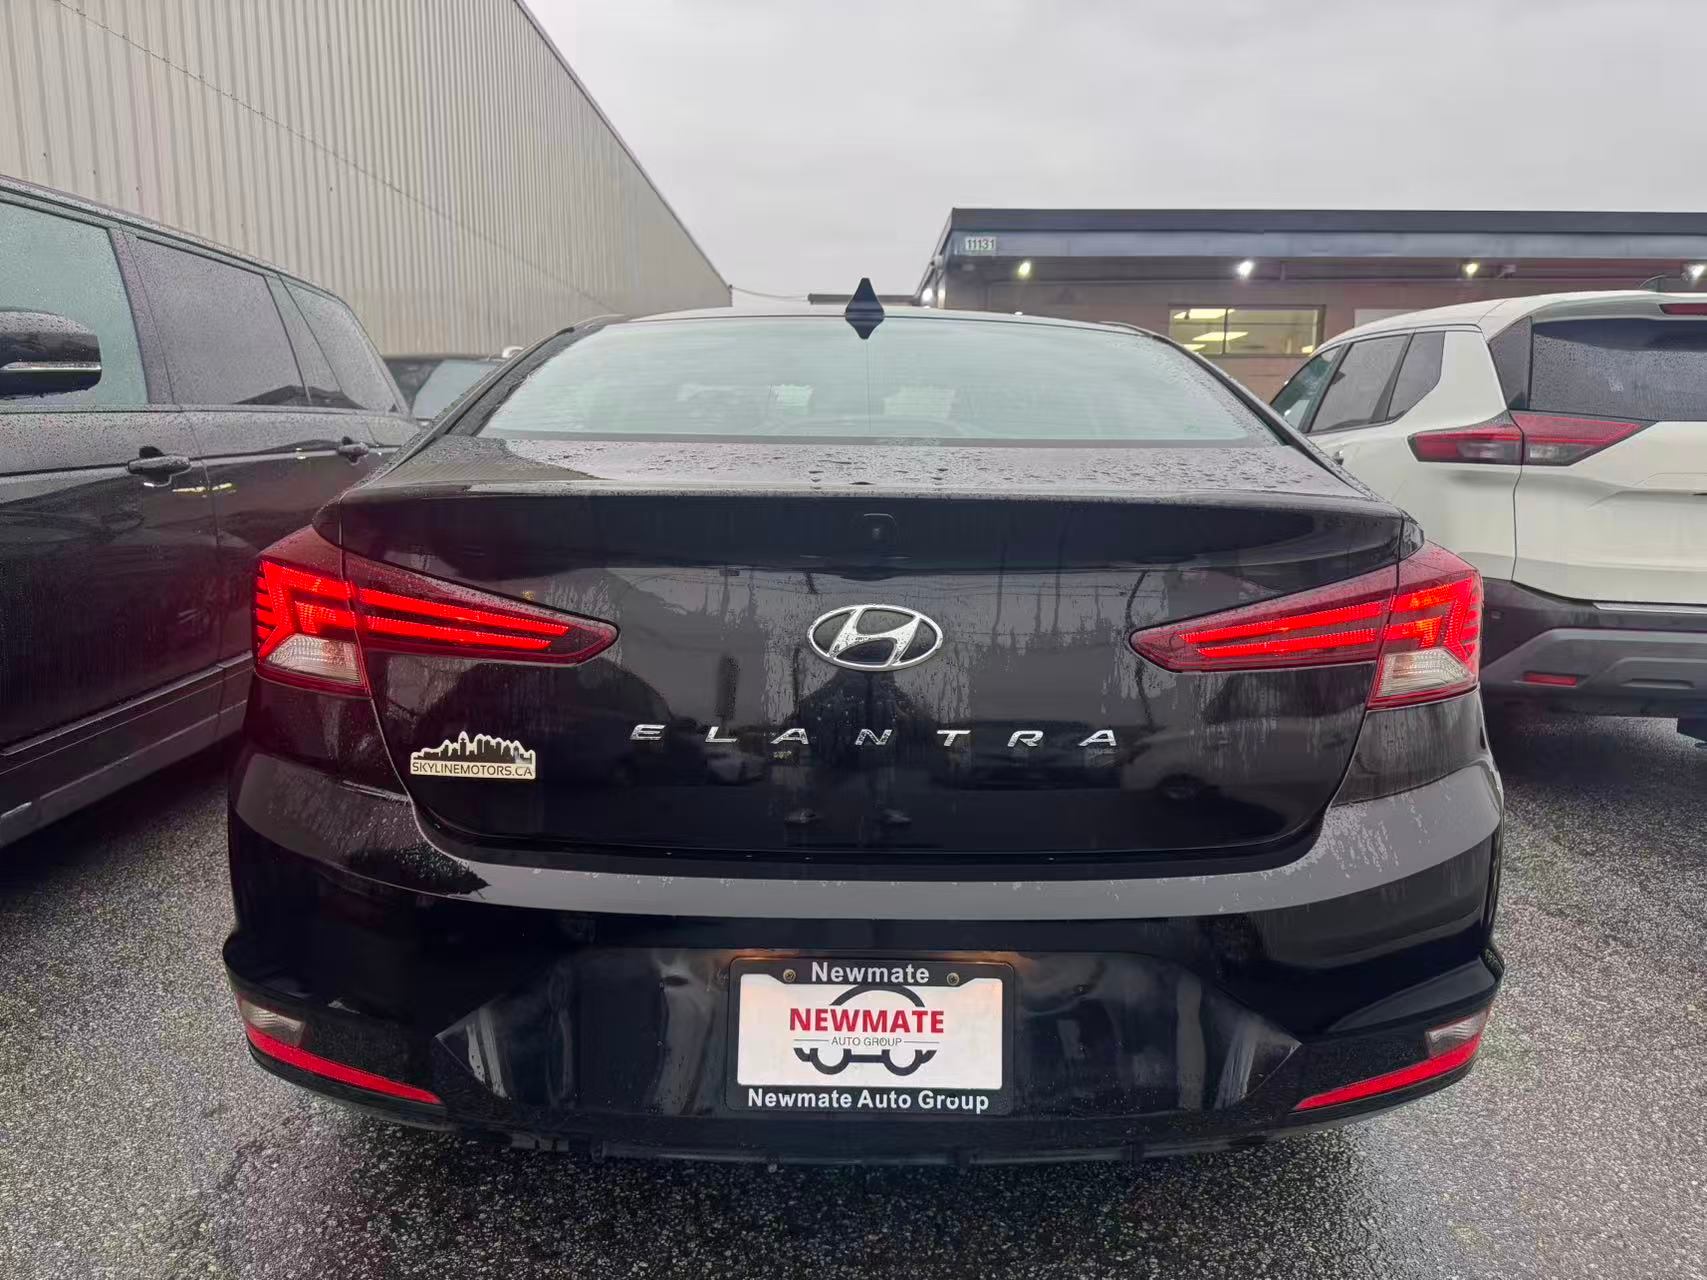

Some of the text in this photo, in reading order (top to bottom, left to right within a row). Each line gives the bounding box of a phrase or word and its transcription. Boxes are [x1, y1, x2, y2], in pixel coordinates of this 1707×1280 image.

[967, 239, 995, 250] 11131
[630, 724, 1118, 748] ELANTRA
[412, 761, 533, 777] SKYLINEMOTORS.CA
[811, 962, 930, 984] Newmate
[789, 1008, 944, 1034] NEWMATE
[831, 1036, 902, 1047] AUTO GROUP
[748, 1088, 989, 1114] Newmate Auto Group
